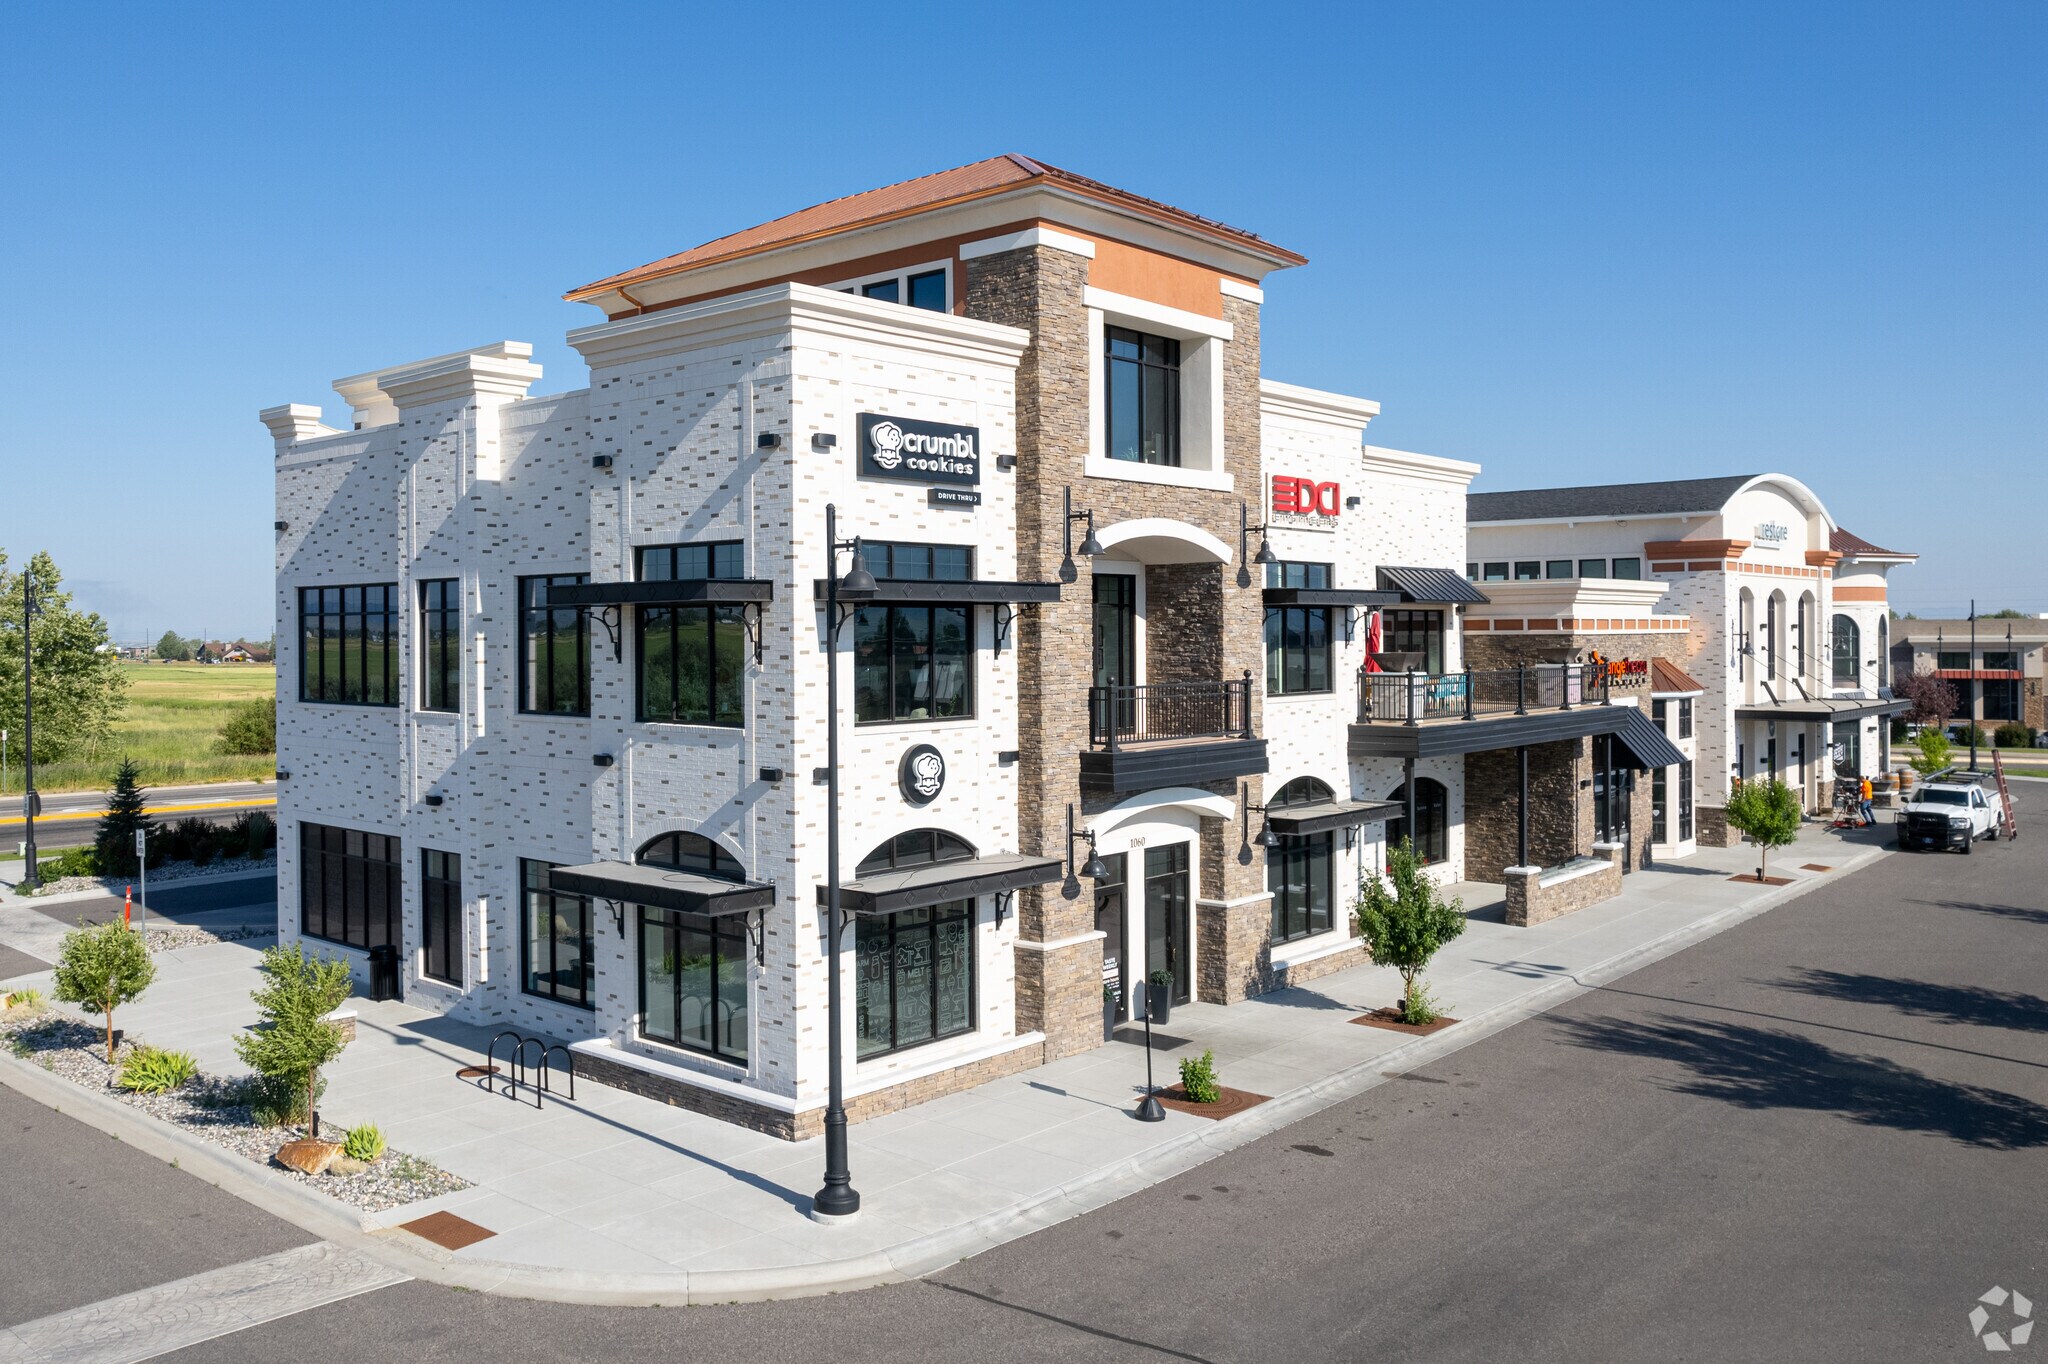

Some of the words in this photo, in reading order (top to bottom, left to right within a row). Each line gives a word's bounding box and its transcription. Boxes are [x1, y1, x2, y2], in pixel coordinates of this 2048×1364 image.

[903, 433, 977, 460] crumbl
[906, 457, 974, 475] cookies
[938, 492, 956, 500] DRIVE
[1130, 836, 1145, 848] 1060
[907, 966, 925, 979] MELT
